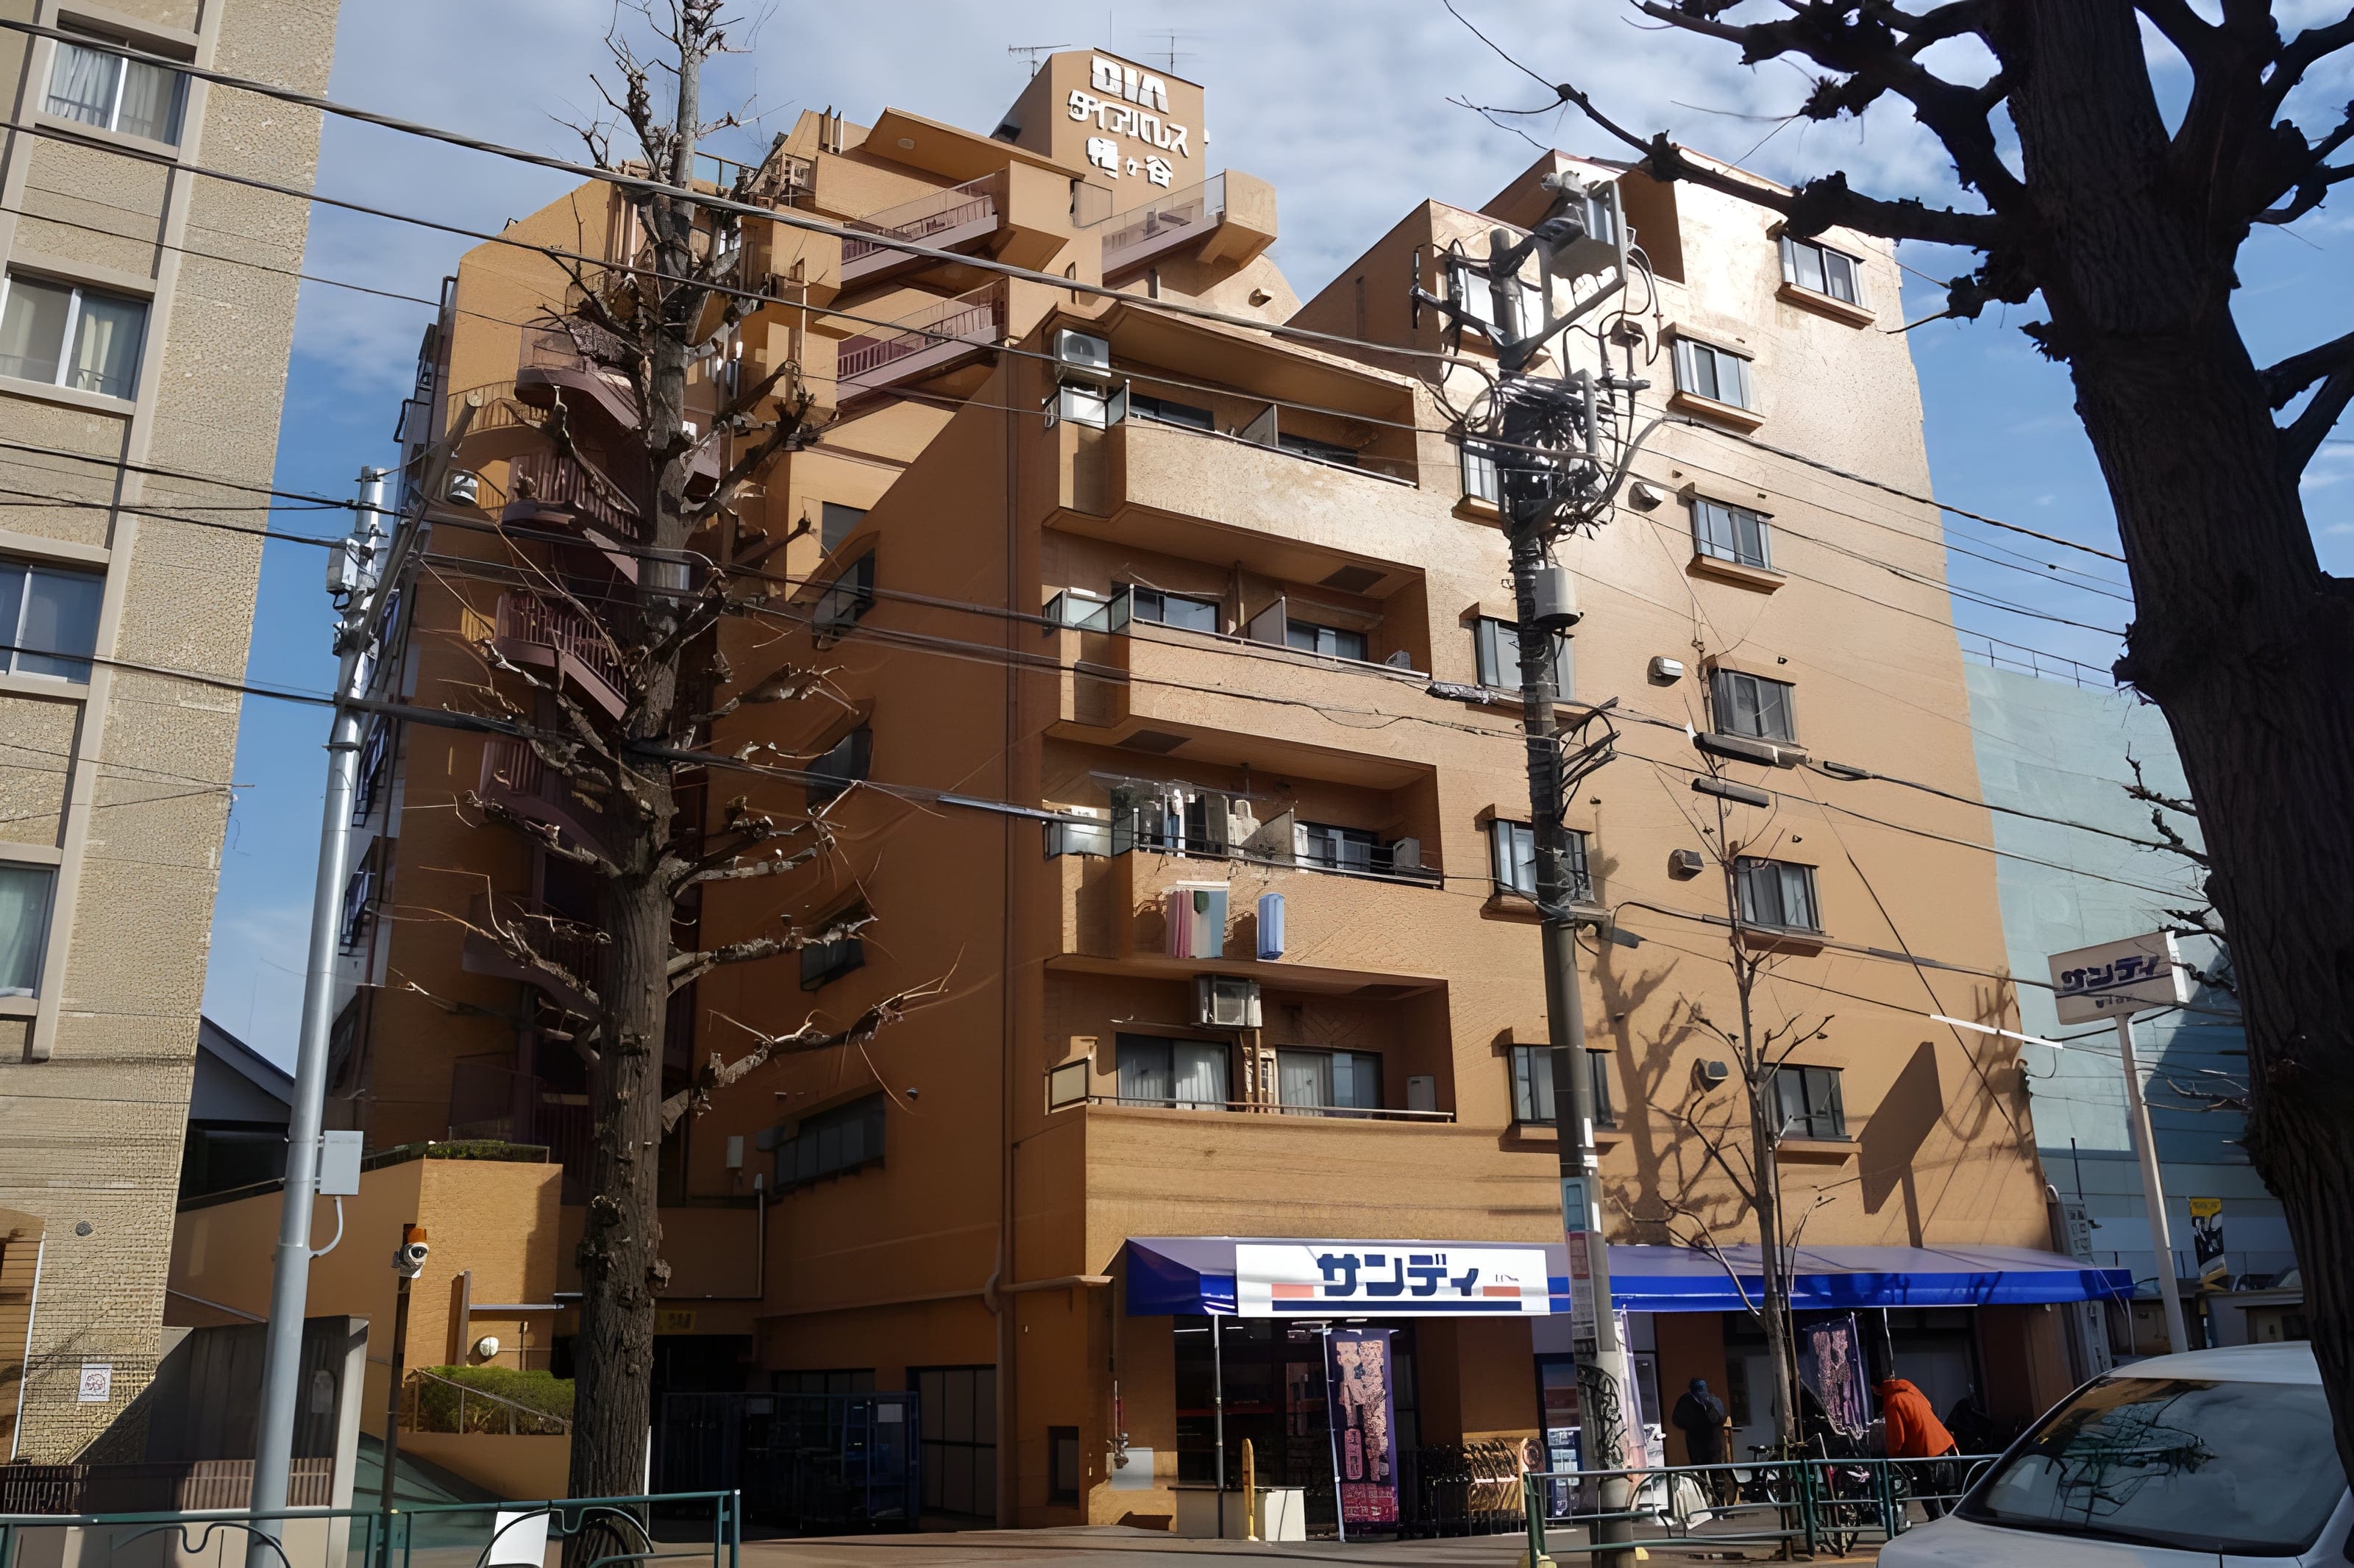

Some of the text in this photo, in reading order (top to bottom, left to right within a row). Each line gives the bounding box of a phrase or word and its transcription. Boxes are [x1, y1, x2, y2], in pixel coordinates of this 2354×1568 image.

[1092, 54, 1168, 114] DIA
[1068, 89, 1188, 157] ダイアパレス
[1317, 1253, 1479, 1296] サンディ
